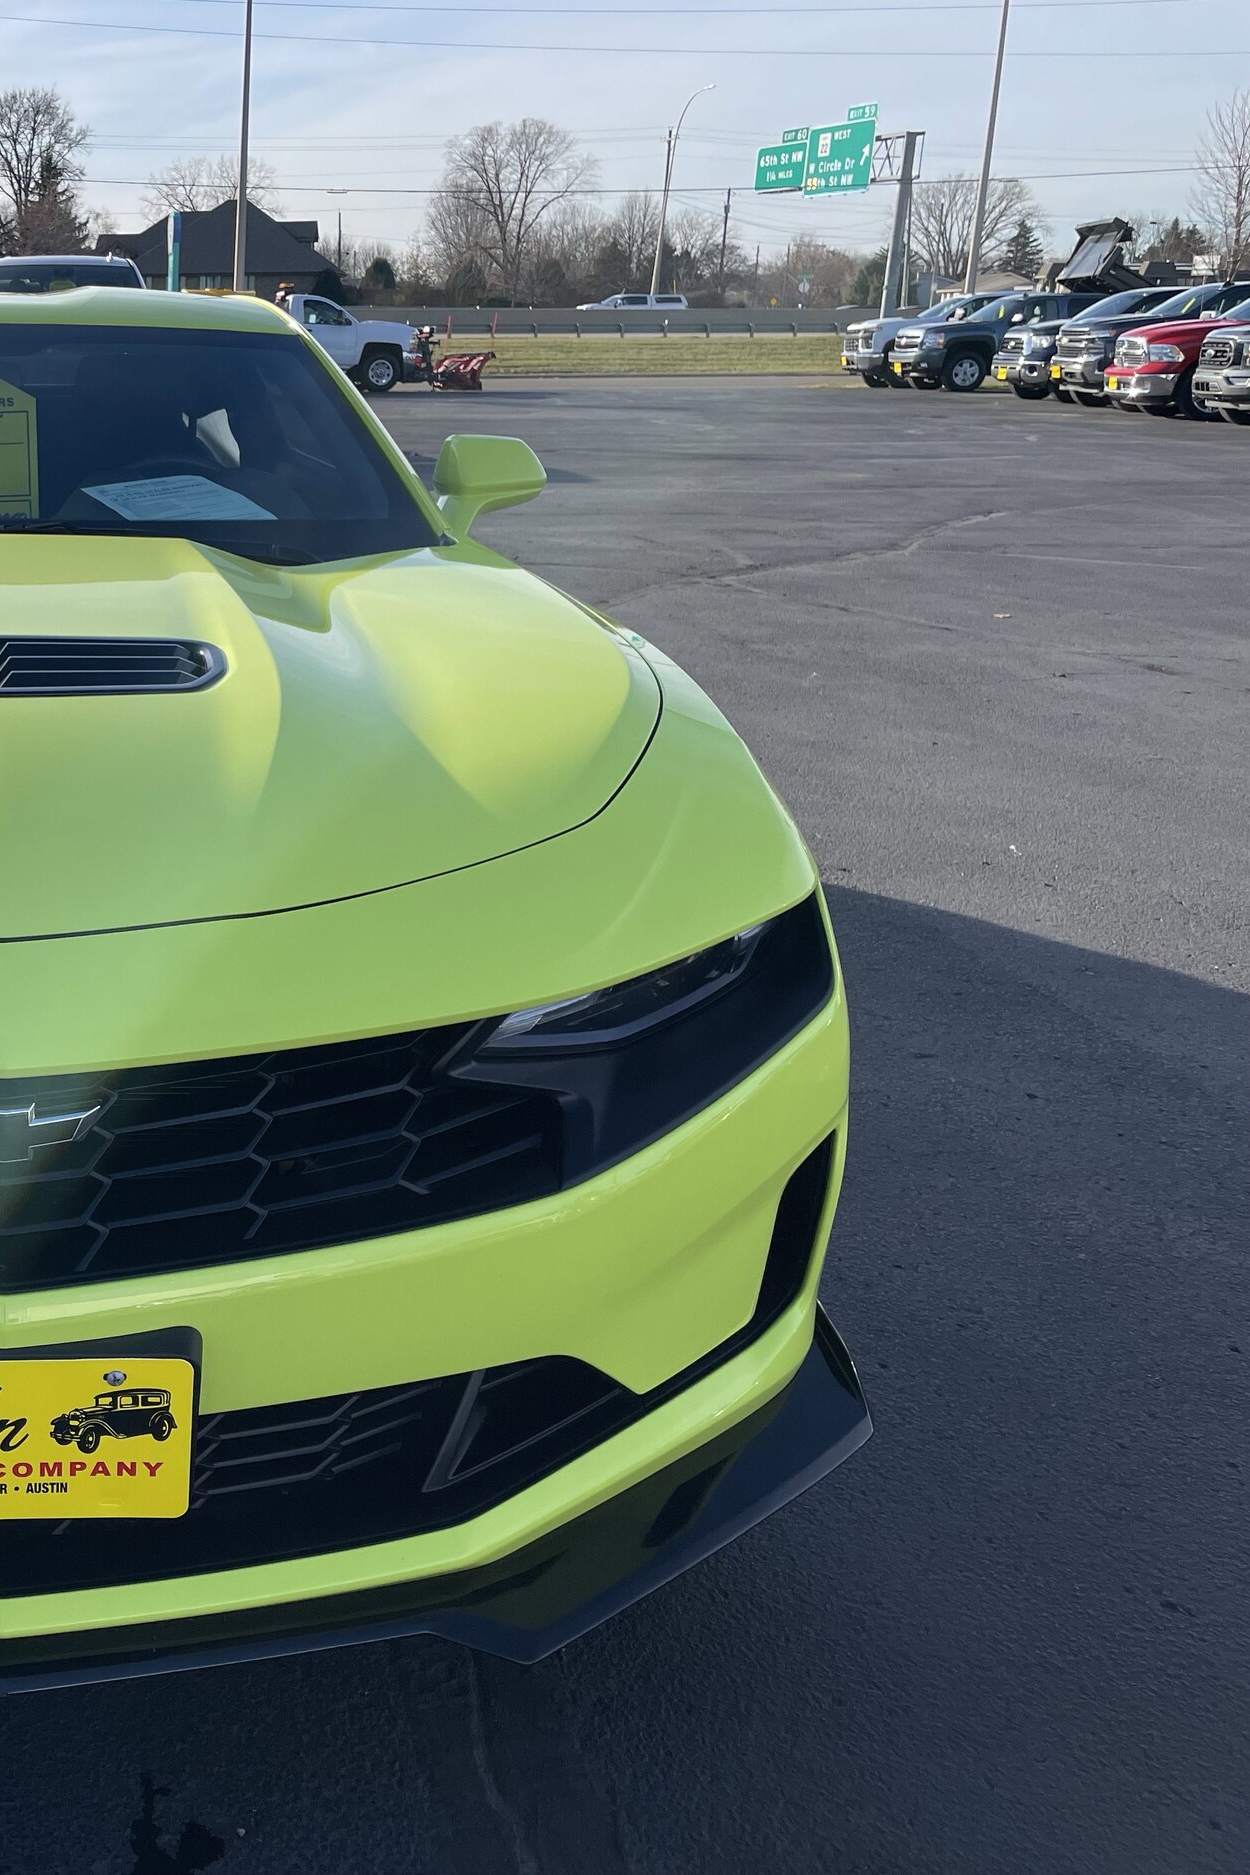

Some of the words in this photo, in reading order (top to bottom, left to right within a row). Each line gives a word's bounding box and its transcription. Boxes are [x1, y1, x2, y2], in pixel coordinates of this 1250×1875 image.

[864, 105, 876, 118] 59
[797, 129, 808, 140] 60
[834, 129, 851, 140] WEST
[820, 143, 829, 154] 22
[760, 155, 777, 167] 65th
[781, 153, 789, 165] St
[792, 151, 803, 163] NW
[809, 162, 816, 174] W
[819, 159, 841, 173] Circle
[844, 157, 855, 170] Dr
[829, 175, 838, 187] St
[841, 174, 853, 186] NW
[25, 1482, 68, 1495] AUSTIN
